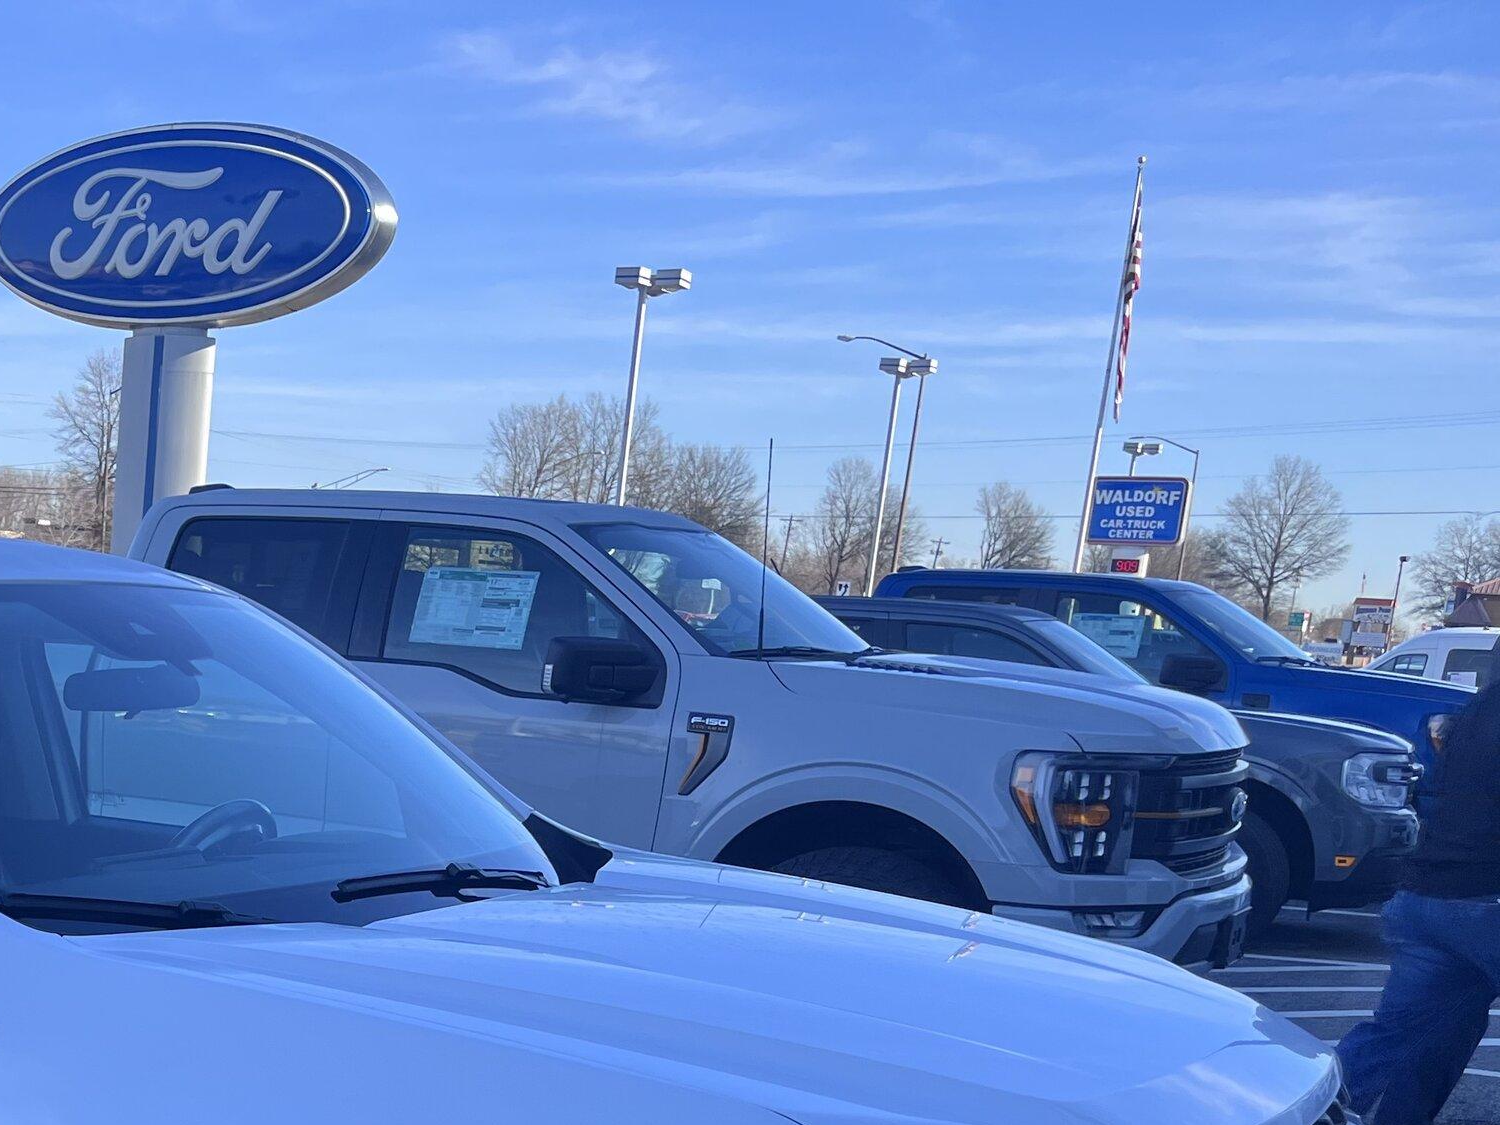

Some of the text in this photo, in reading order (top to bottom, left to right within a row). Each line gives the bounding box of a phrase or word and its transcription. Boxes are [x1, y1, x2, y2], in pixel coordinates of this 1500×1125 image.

[49, 166, 283, 280] Ford
[1094, 489, 1182, 506] WALDORF
[1115, 506, 1155, 517] USED
[1099, 519, 1167, 529] CAR-TRUCK
[1108, 530, 1155, 539] CENTER
[690, 716, 729, 727] F-150
